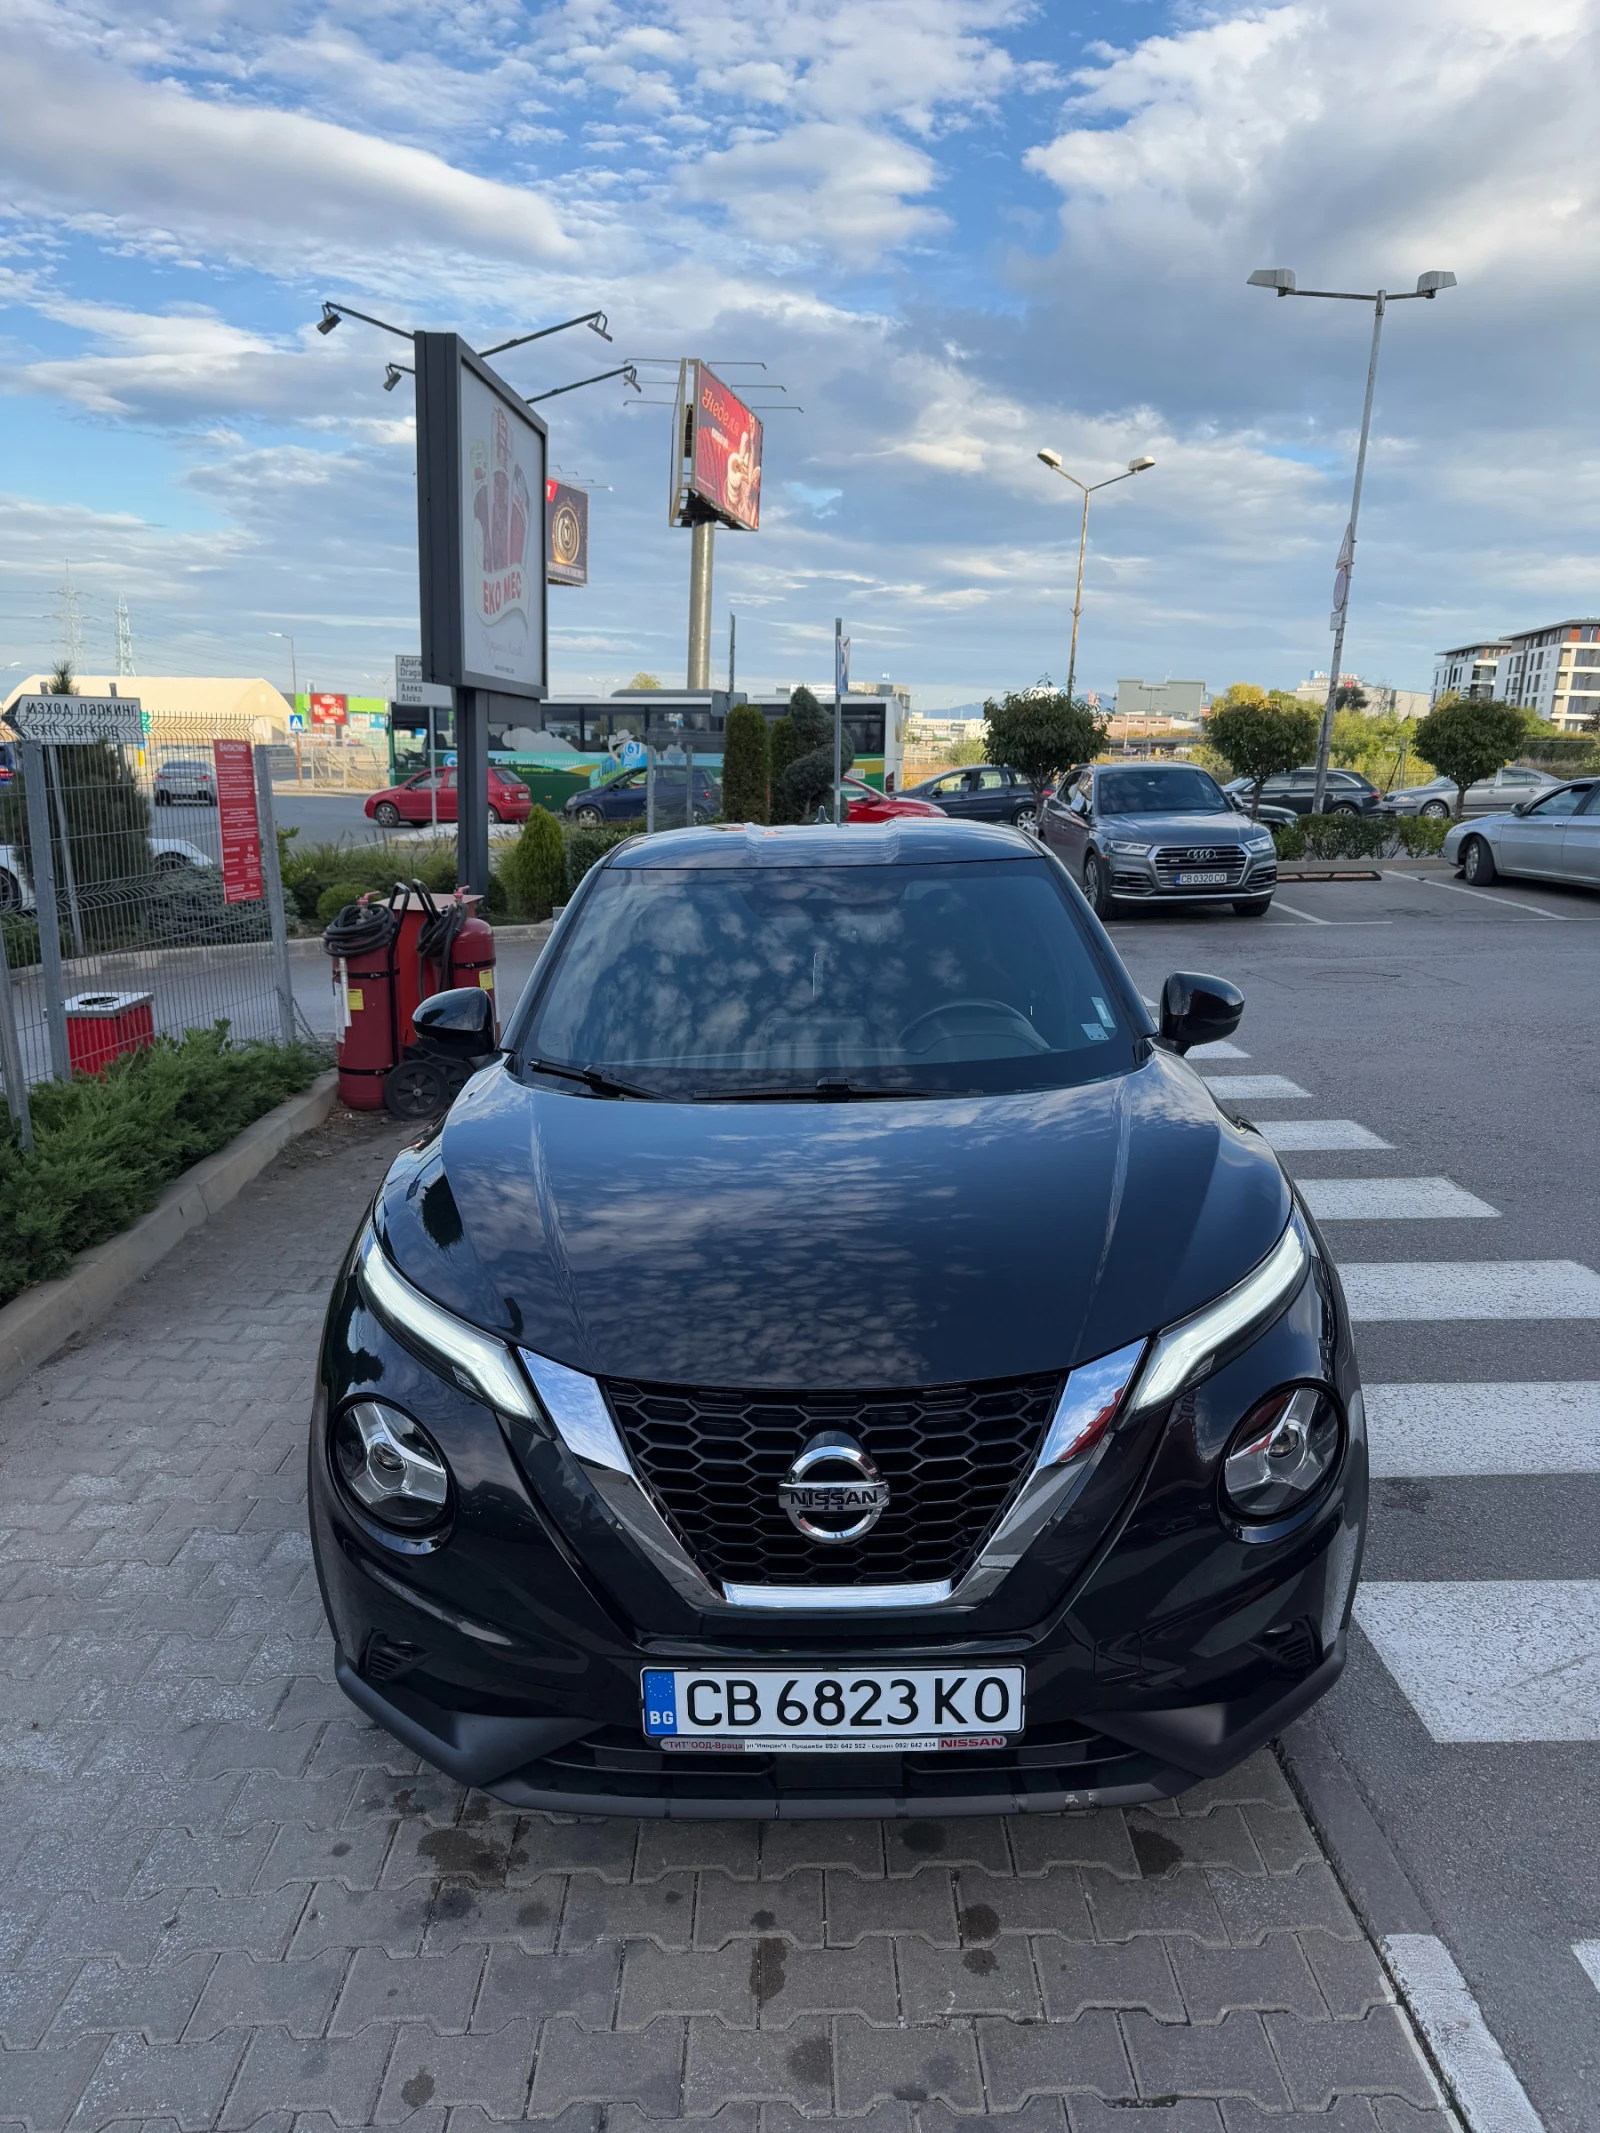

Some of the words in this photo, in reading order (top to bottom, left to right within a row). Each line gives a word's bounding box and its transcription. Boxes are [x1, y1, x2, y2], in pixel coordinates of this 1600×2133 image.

[401, 693, 422, 702] Aleko
[27, 702, 72, 716] изход
[79, 703, 137, 719] паркинг
[66, 721, 120, 740] parking
[626, 743, 641, 754] 61
[1181, 874, 1192, 884] CB
[1193, 873, 1213, 883] 0320
[790, 1489, 878, 1506] NISSAN
[687, 1679, 761, 1726] CB
[777, 1679, 919, 1726] 6823
[934, 1677, 1010, 1725] KO
[649, 1710, 674, 1725] BG
[940, 1737, 1003, 1748] NISSAN
